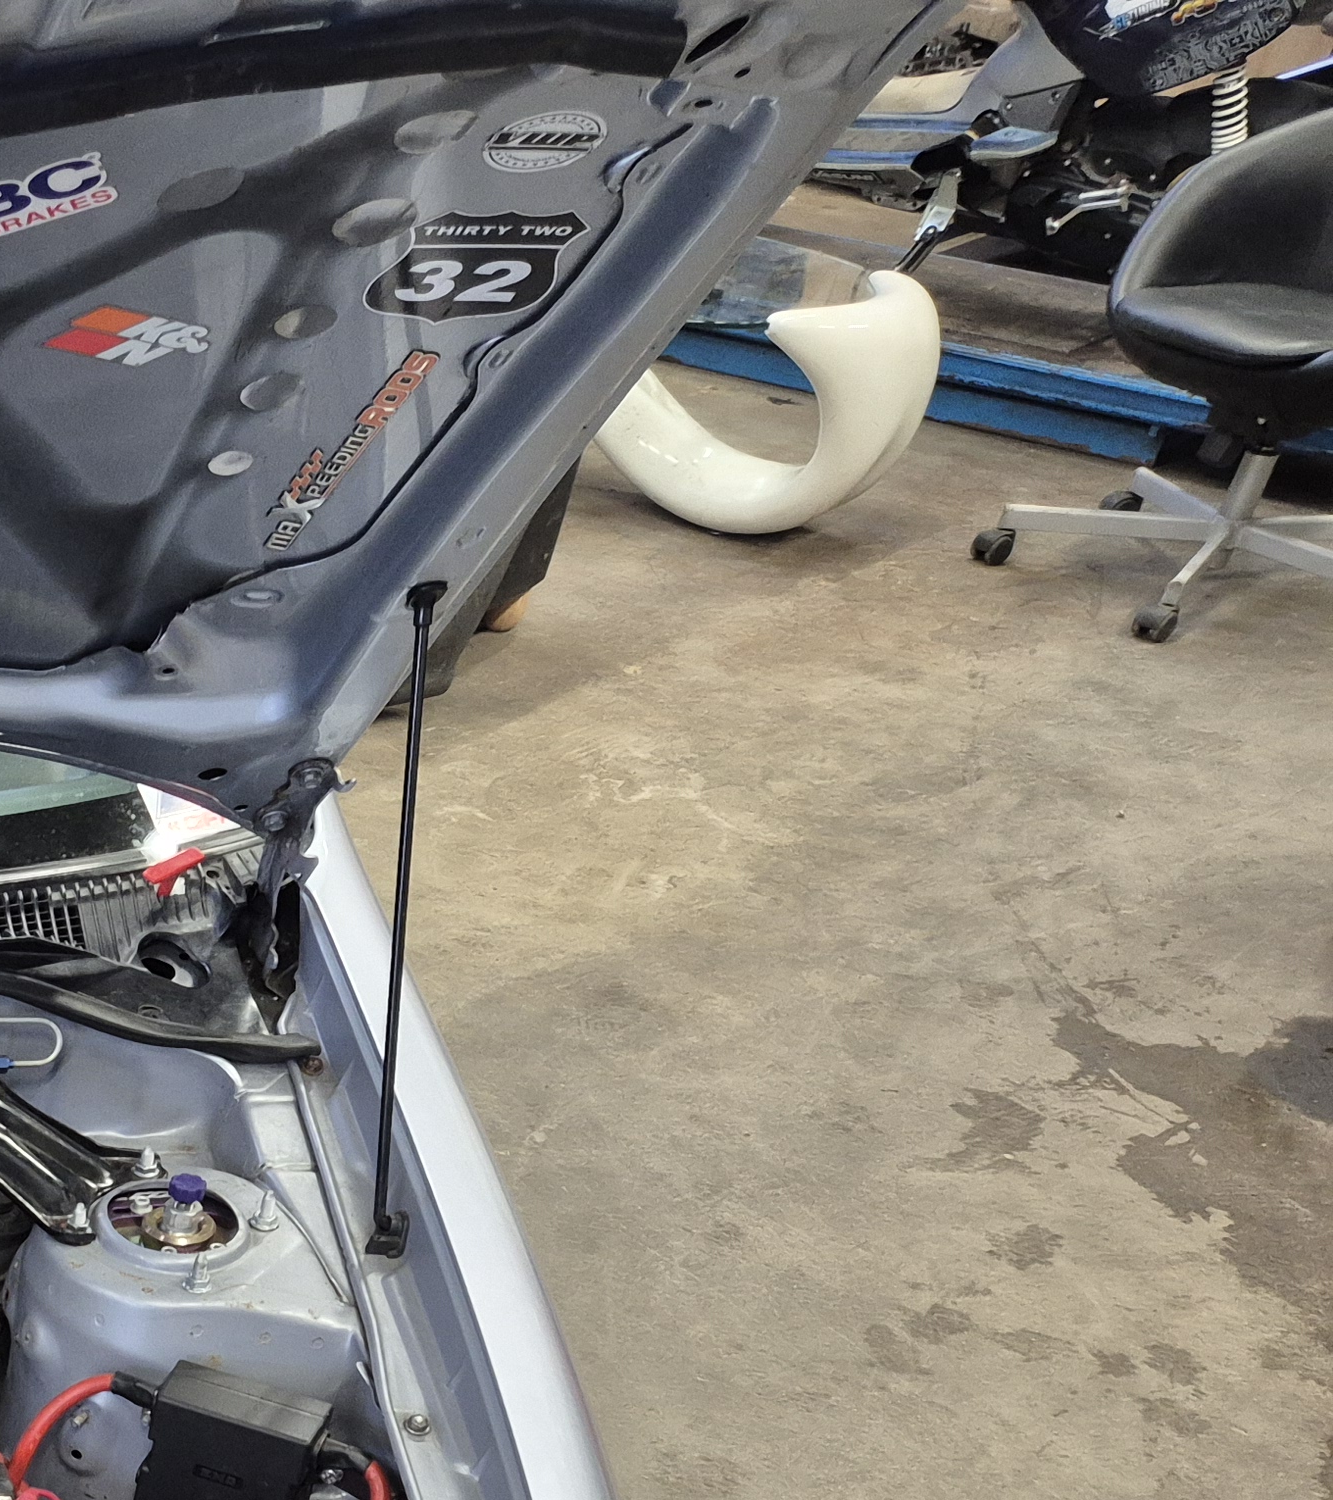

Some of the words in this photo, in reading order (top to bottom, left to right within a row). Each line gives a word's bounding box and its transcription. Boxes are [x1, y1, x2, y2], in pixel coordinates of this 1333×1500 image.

[423, 224, 515, 238] THIRTY
[521, 224, 575, 238] TWO
[394, 260, 533, 303] 32
[95, 316, 210, 367] K&N
